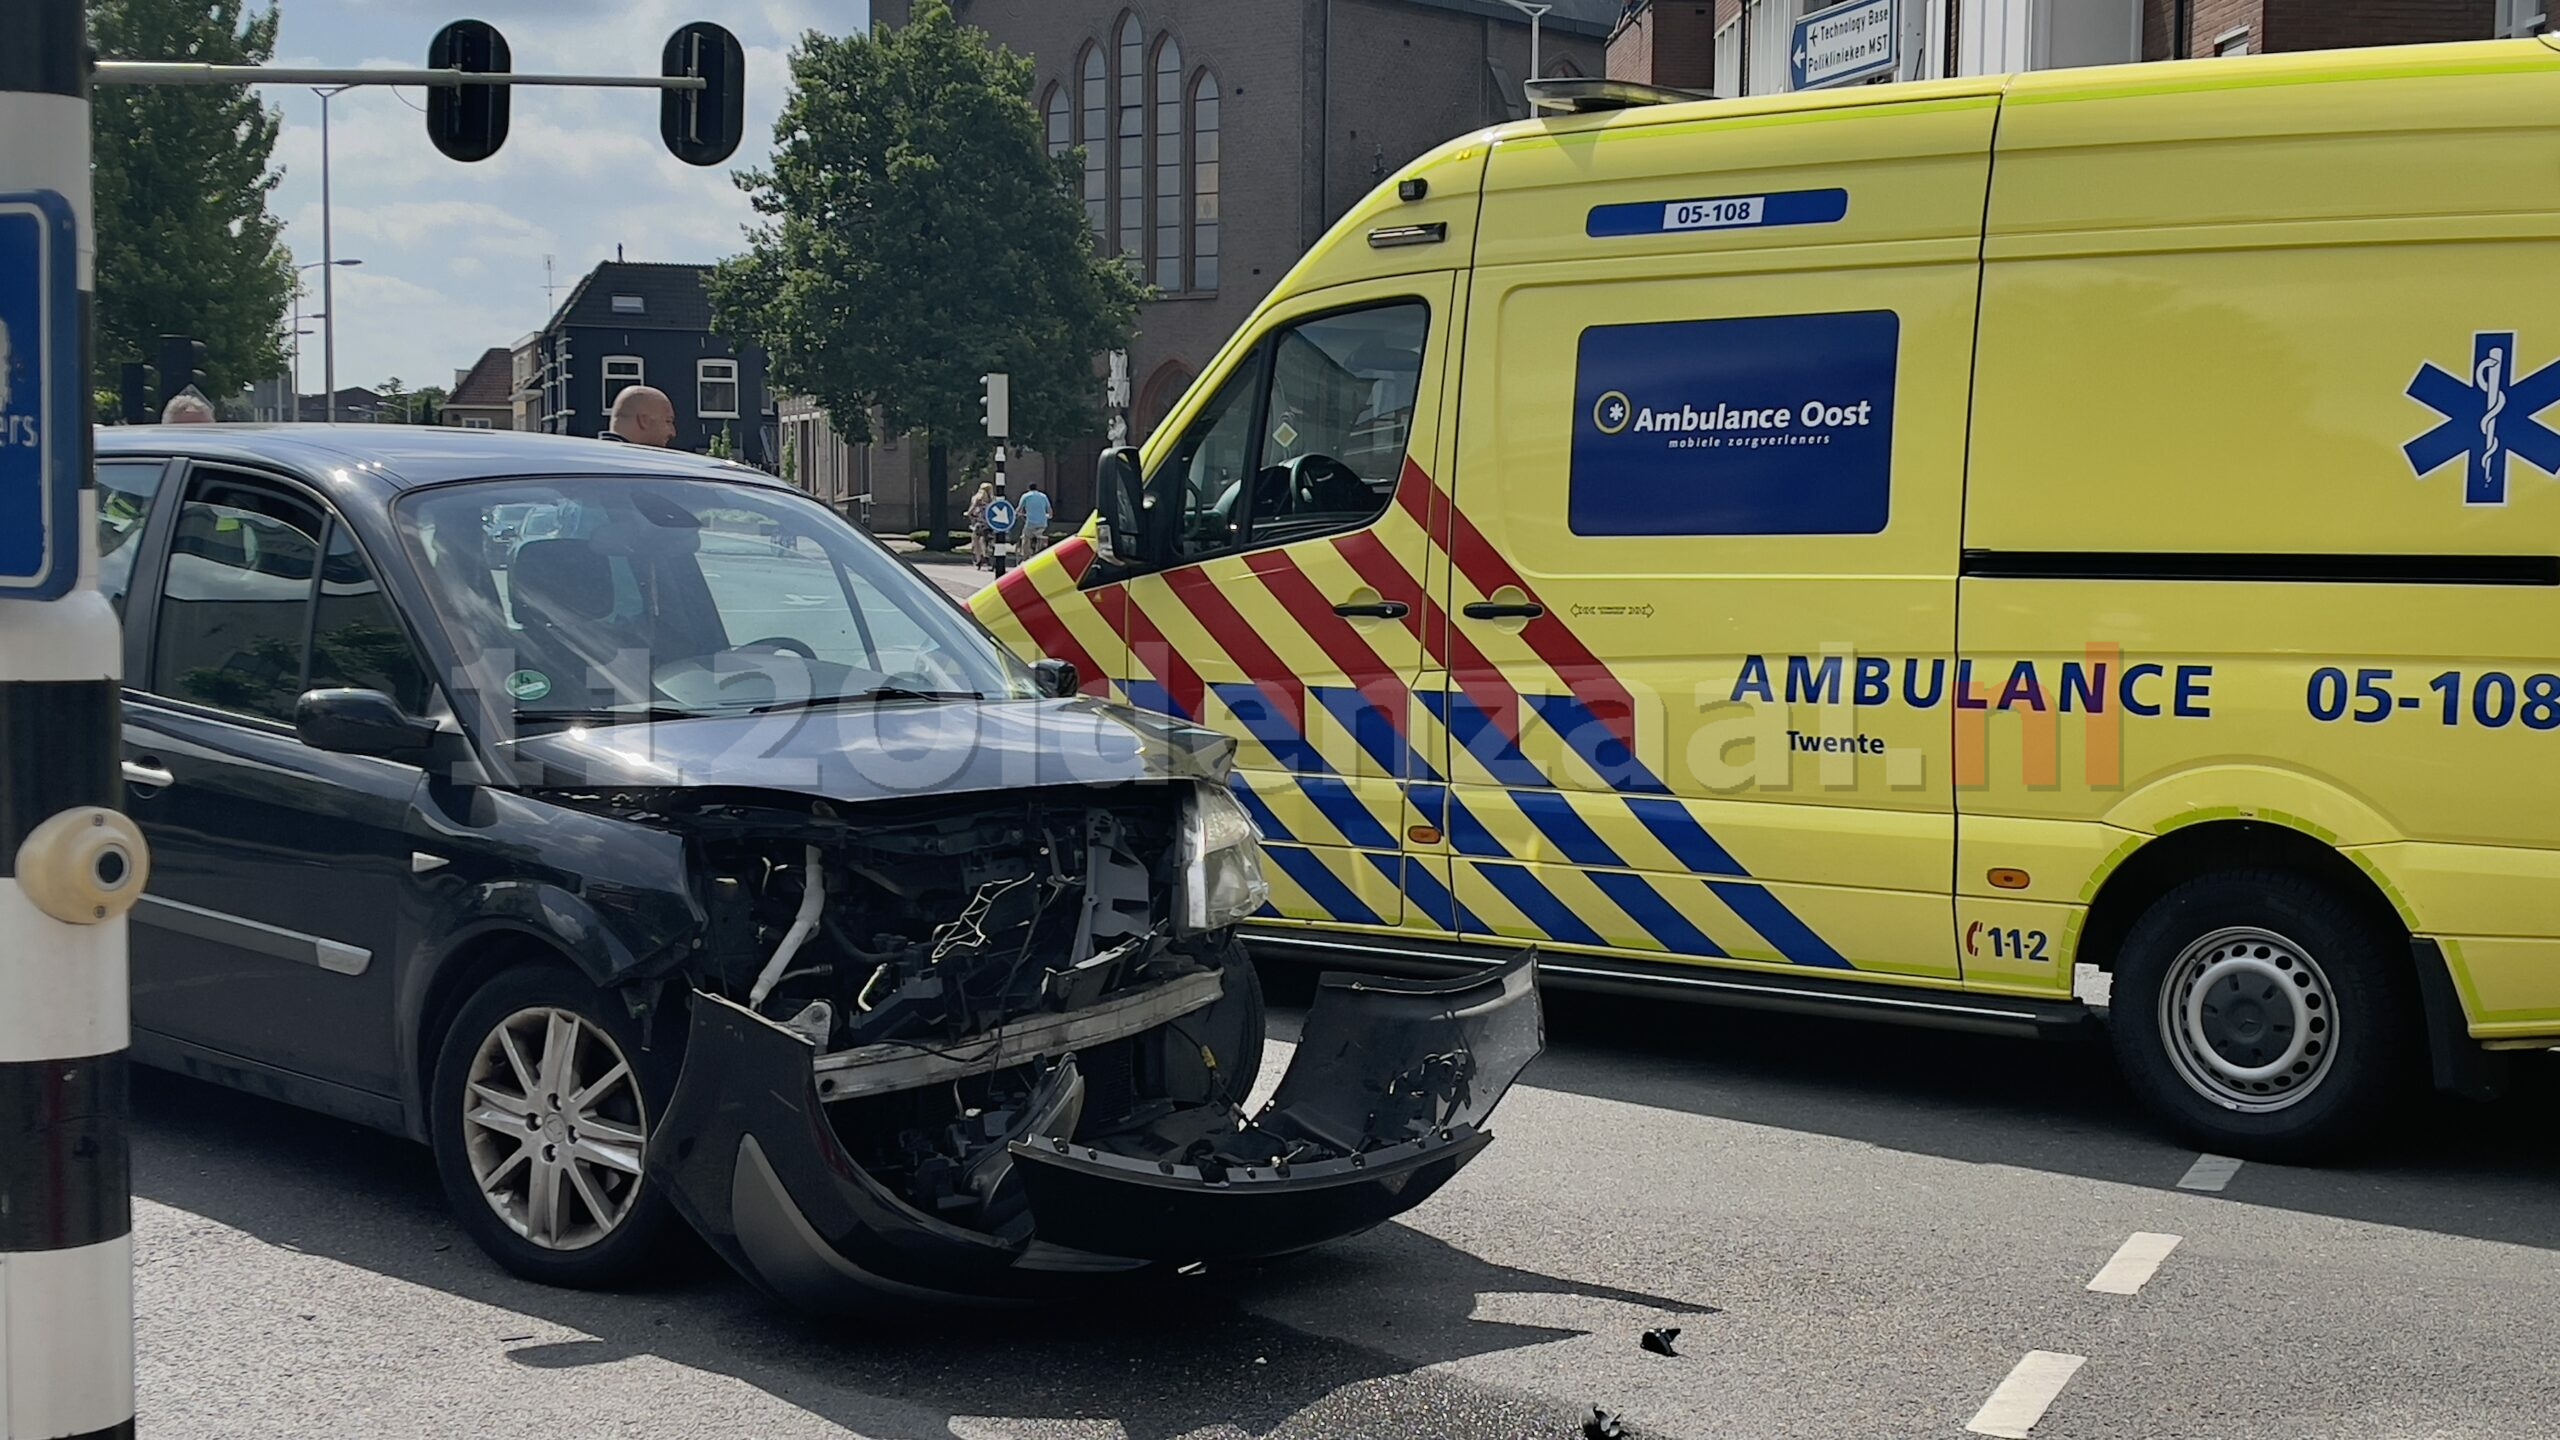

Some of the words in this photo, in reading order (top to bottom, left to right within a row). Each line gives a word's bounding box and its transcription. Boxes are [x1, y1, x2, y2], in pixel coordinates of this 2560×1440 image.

[1820, 16, 1866, 40] Technology
[1868, 8, 1889, 26] Base
[1808, 44, 1865, 73] Poliklinieken
[1868, 34, 1887, 55] MST
[1677, 202, 1751, 224] 05-108
[1633, 402, 1791, 433] Ambulance
[1800, 399, 1872, 428] Oost
[1668, 438, 1721, 449] mobiele
[1727, 433, 1831, 449] zorgverleners
[1729, 653, 2215, 719] AMBULANCE
[2306, 666, 2560, 730] 05-108
[1786, 730, 1886, 756] Twente
[1987, 926, 2050, 962] 1-1-2
